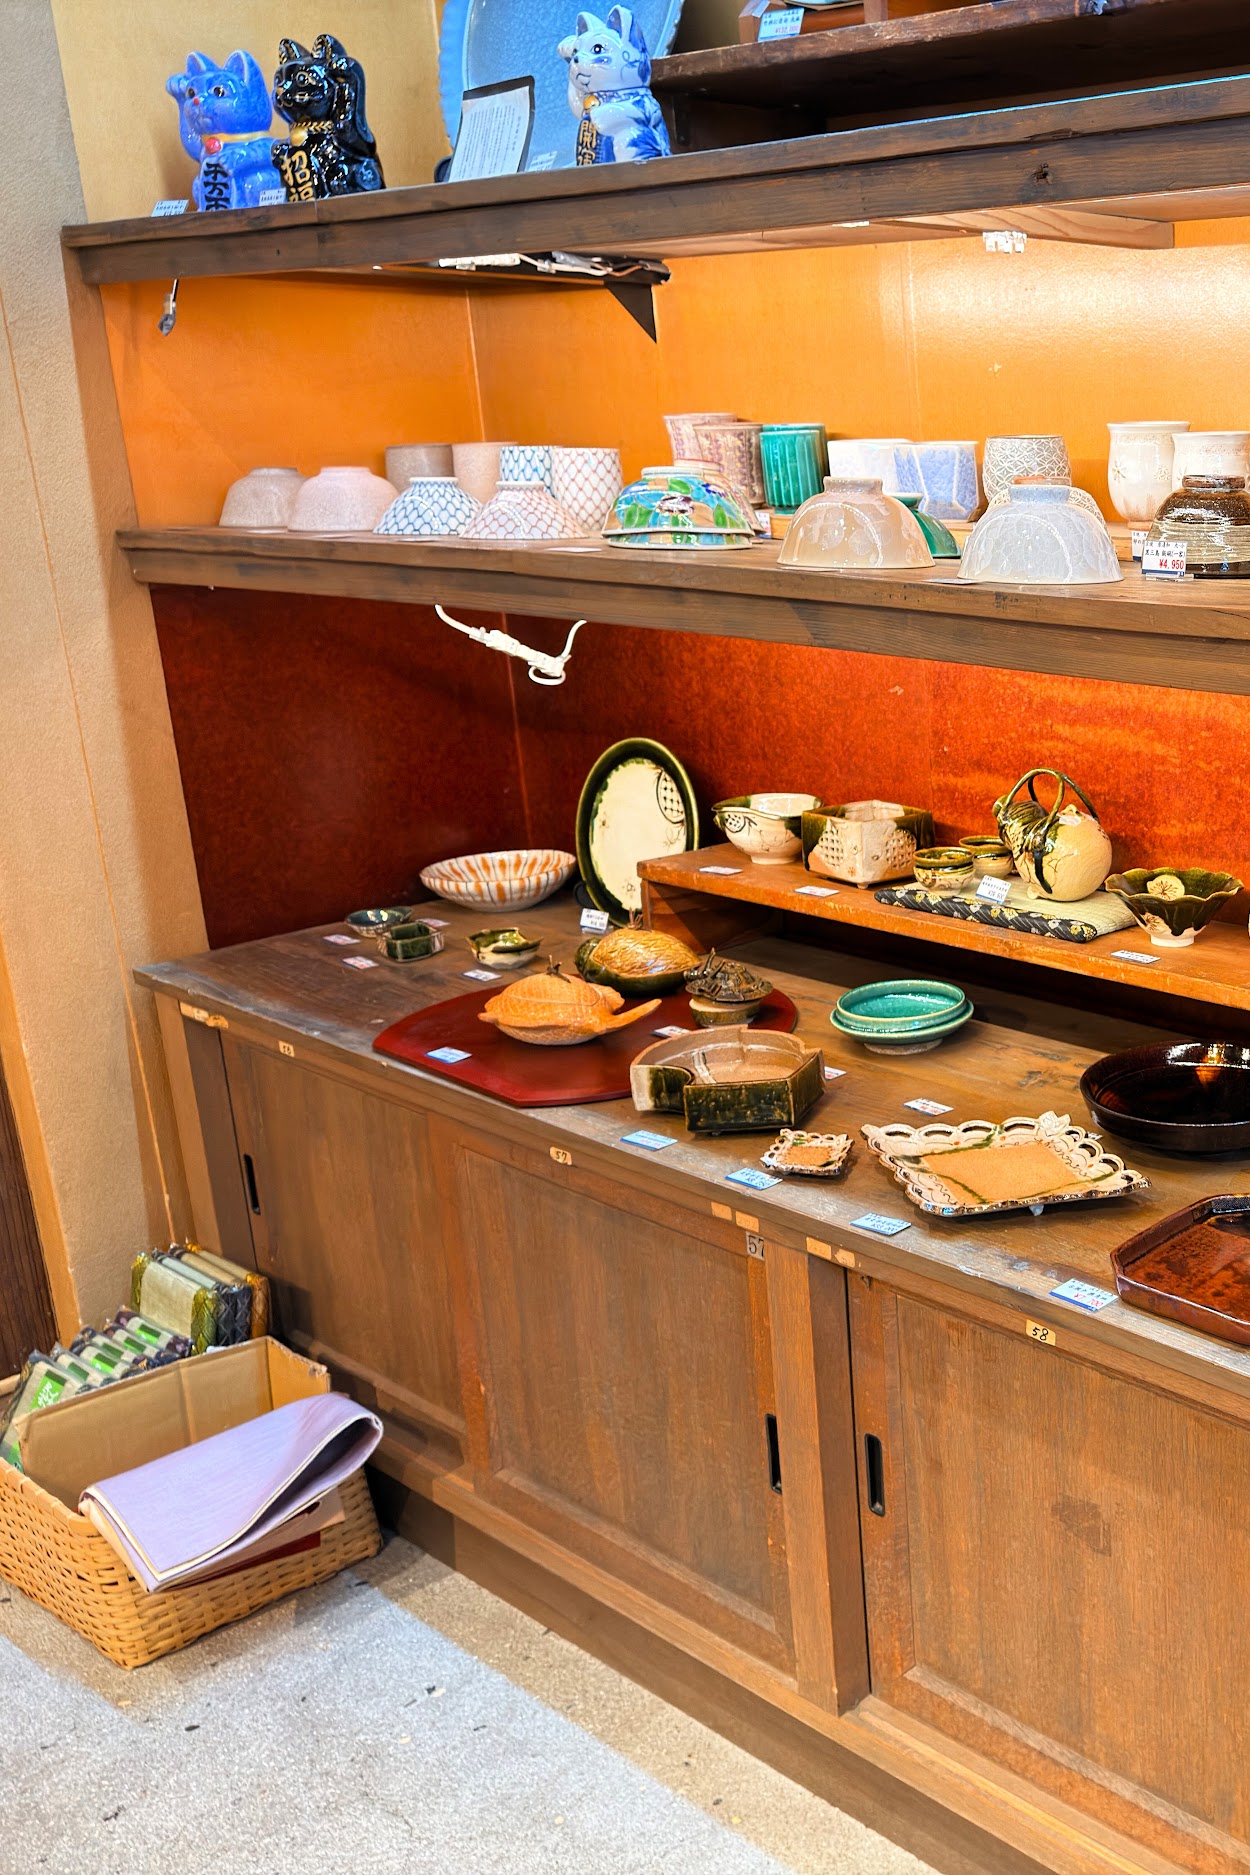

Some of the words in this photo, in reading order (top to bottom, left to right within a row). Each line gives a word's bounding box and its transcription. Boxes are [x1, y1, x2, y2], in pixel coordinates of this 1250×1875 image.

[1159, 559, 1184, 570] ¥4,950
[748, 1234, 765, 1258] 57
[1032, 1326, 1049, 1341] 58
